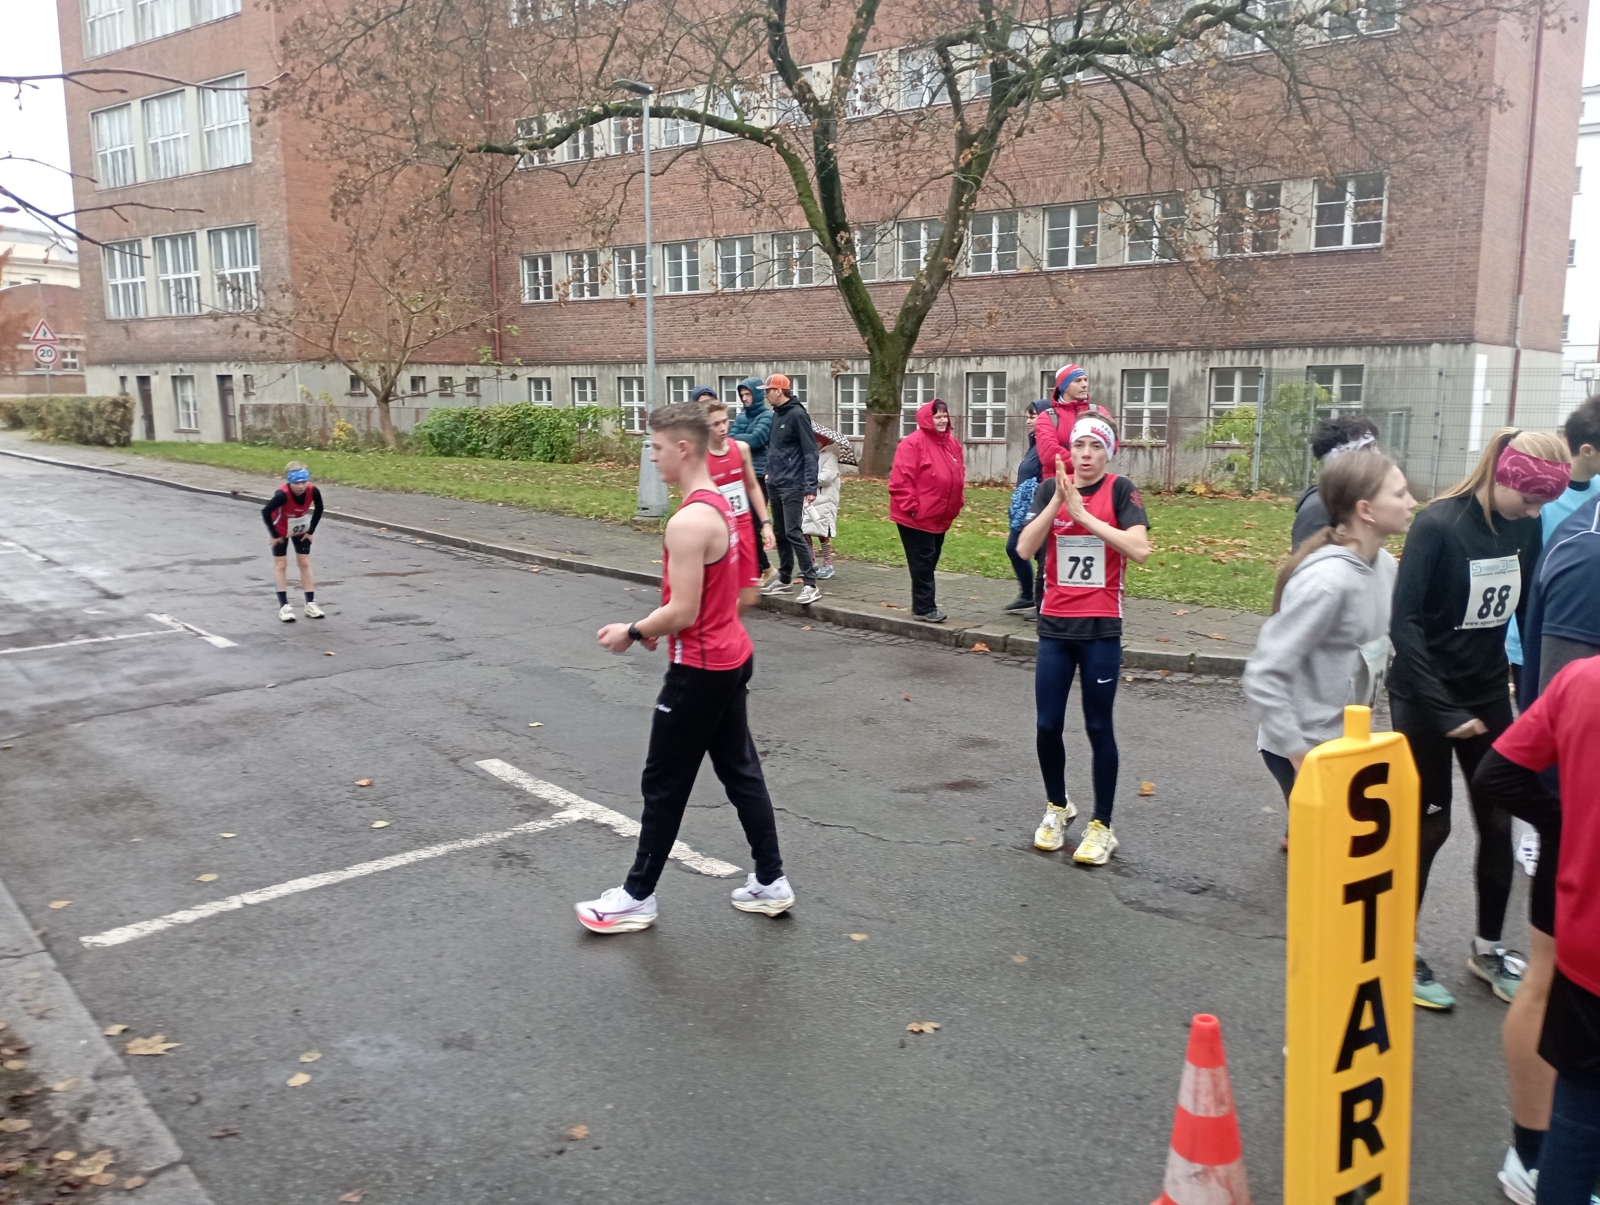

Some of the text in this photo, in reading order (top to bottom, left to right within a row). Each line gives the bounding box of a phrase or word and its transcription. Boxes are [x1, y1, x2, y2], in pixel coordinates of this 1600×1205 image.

[40, 349, 53, 357] 20
[1067, 556, 1095, 580] 78
[1477, 585, 1512, 620] 88
